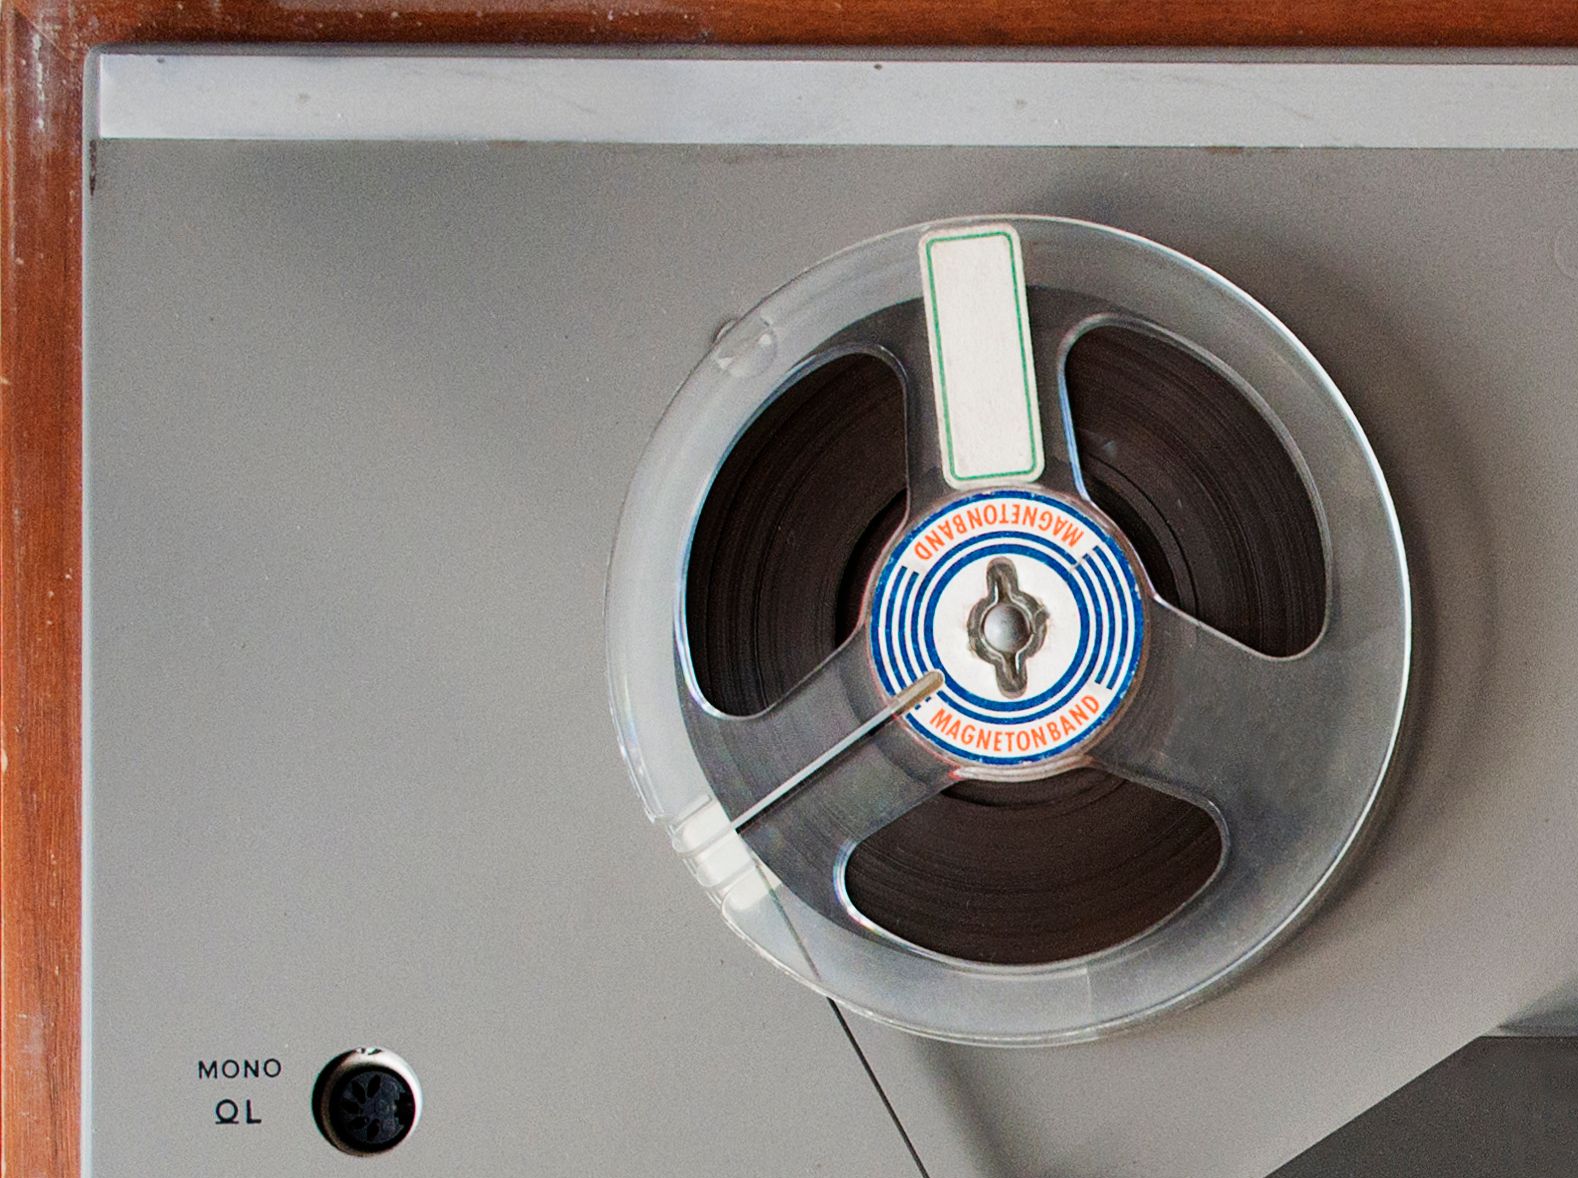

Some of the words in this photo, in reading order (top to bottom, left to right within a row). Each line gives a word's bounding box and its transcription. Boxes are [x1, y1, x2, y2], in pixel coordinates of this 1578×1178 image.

[913, 503, 1085, 561] MAGNETONBAND
[929, 694, 1101, 753] MAGNETONBAND
[197, 1057, 283, 1079] MONO
